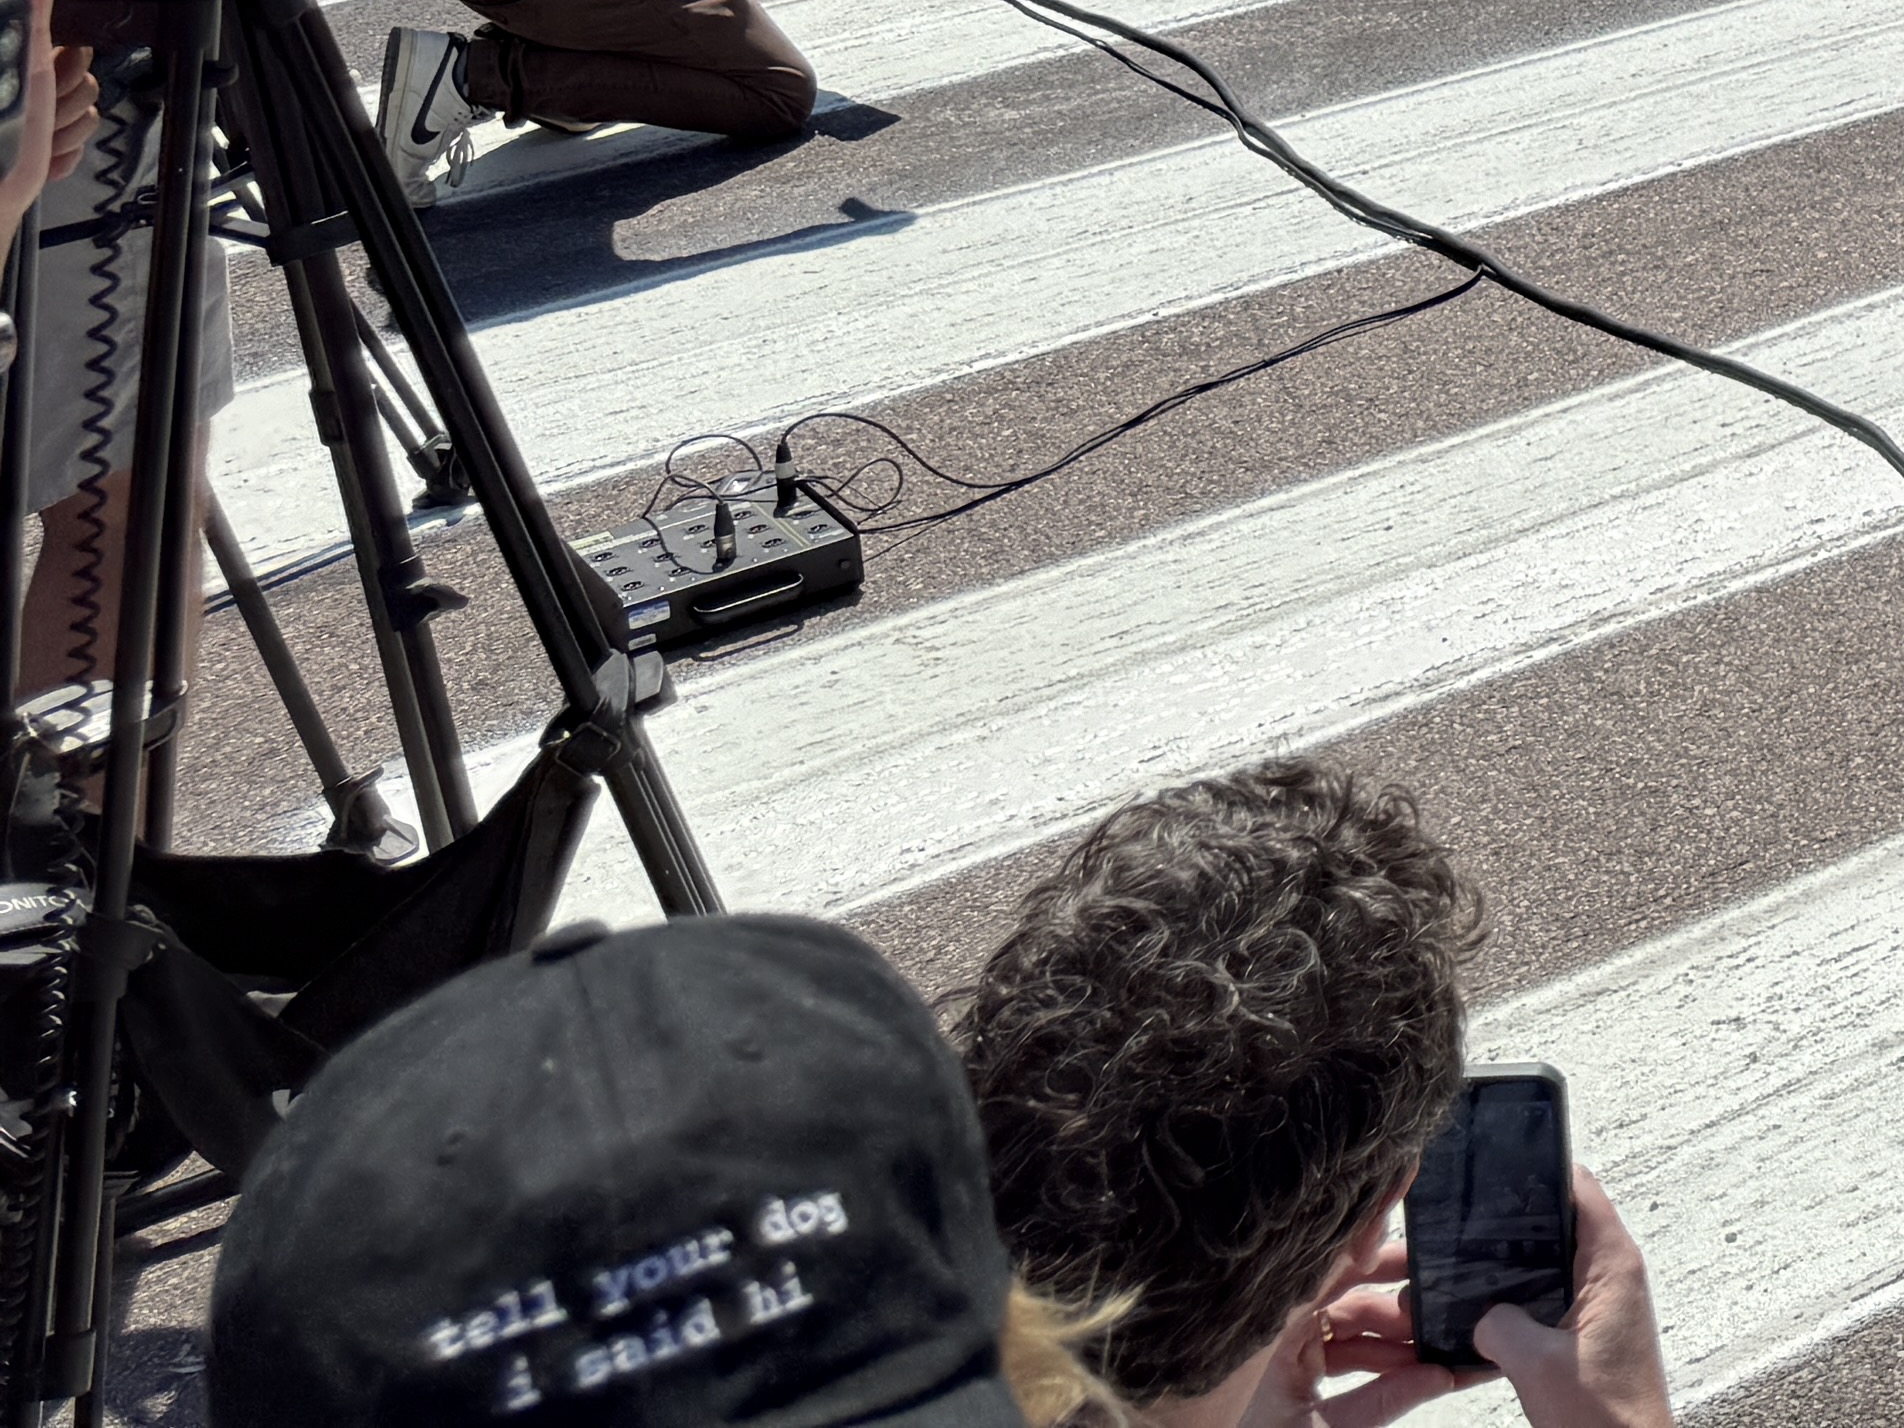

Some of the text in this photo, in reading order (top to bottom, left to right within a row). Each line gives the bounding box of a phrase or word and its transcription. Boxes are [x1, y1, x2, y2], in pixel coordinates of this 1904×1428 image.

[427, 1192, 849, 1361] tell your dog
[504, 1258, 815, 1412] i said hi
